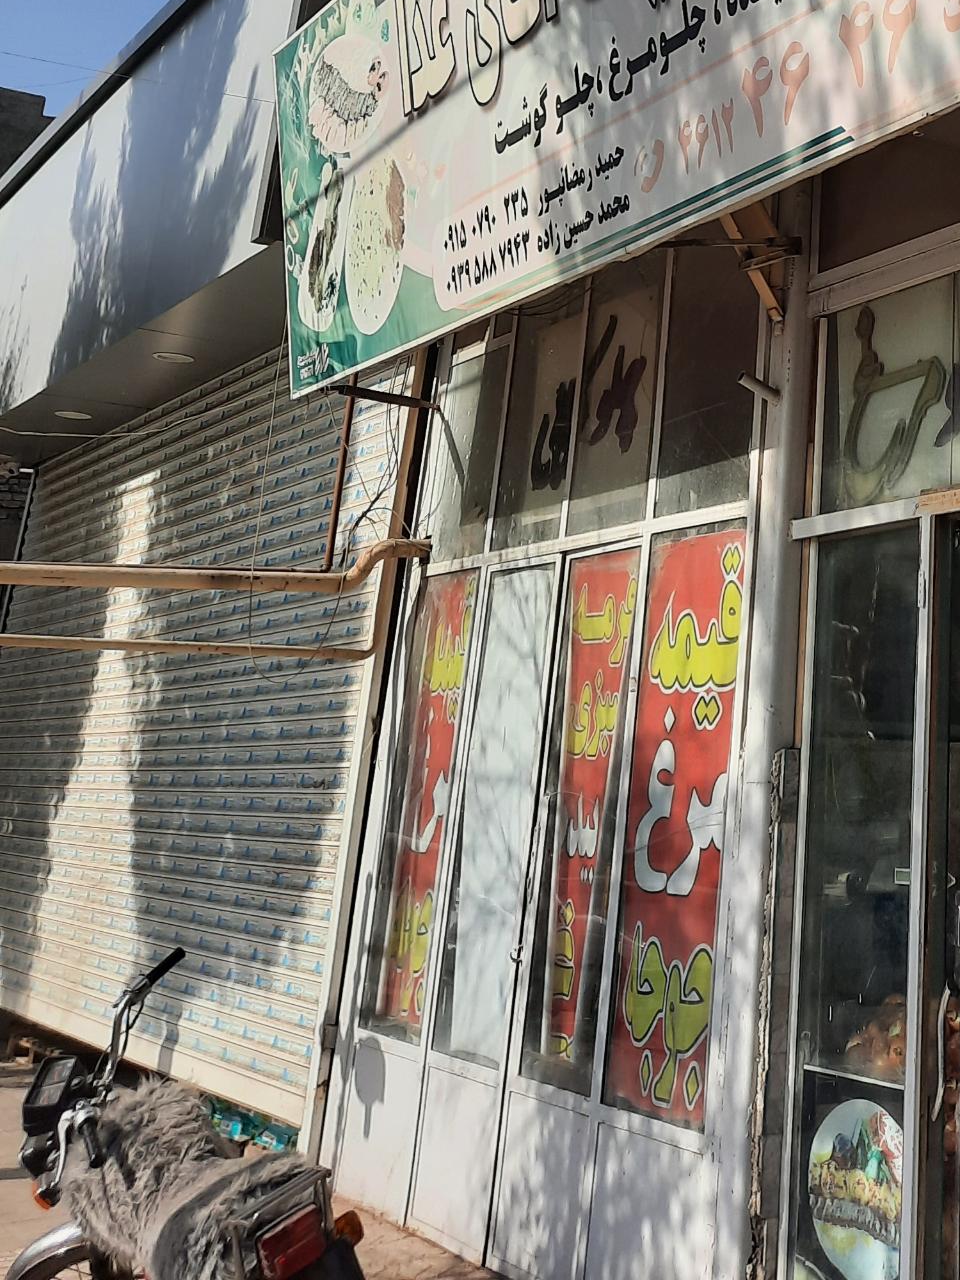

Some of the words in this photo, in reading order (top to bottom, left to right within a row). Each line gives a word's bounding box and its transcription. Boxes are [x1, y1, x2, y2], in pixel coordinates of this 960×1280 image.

[494, 83, 548, 154] گوشت
[594, 146, 625, 181] حمید
[597, 193, 631, 225] محمد
[537, 219, 560, 256] زاده
[563, 210, 594, 250] حسین
[650, 544, 741, 729] قیمه
[634, 705, 727, 896] مرغ
